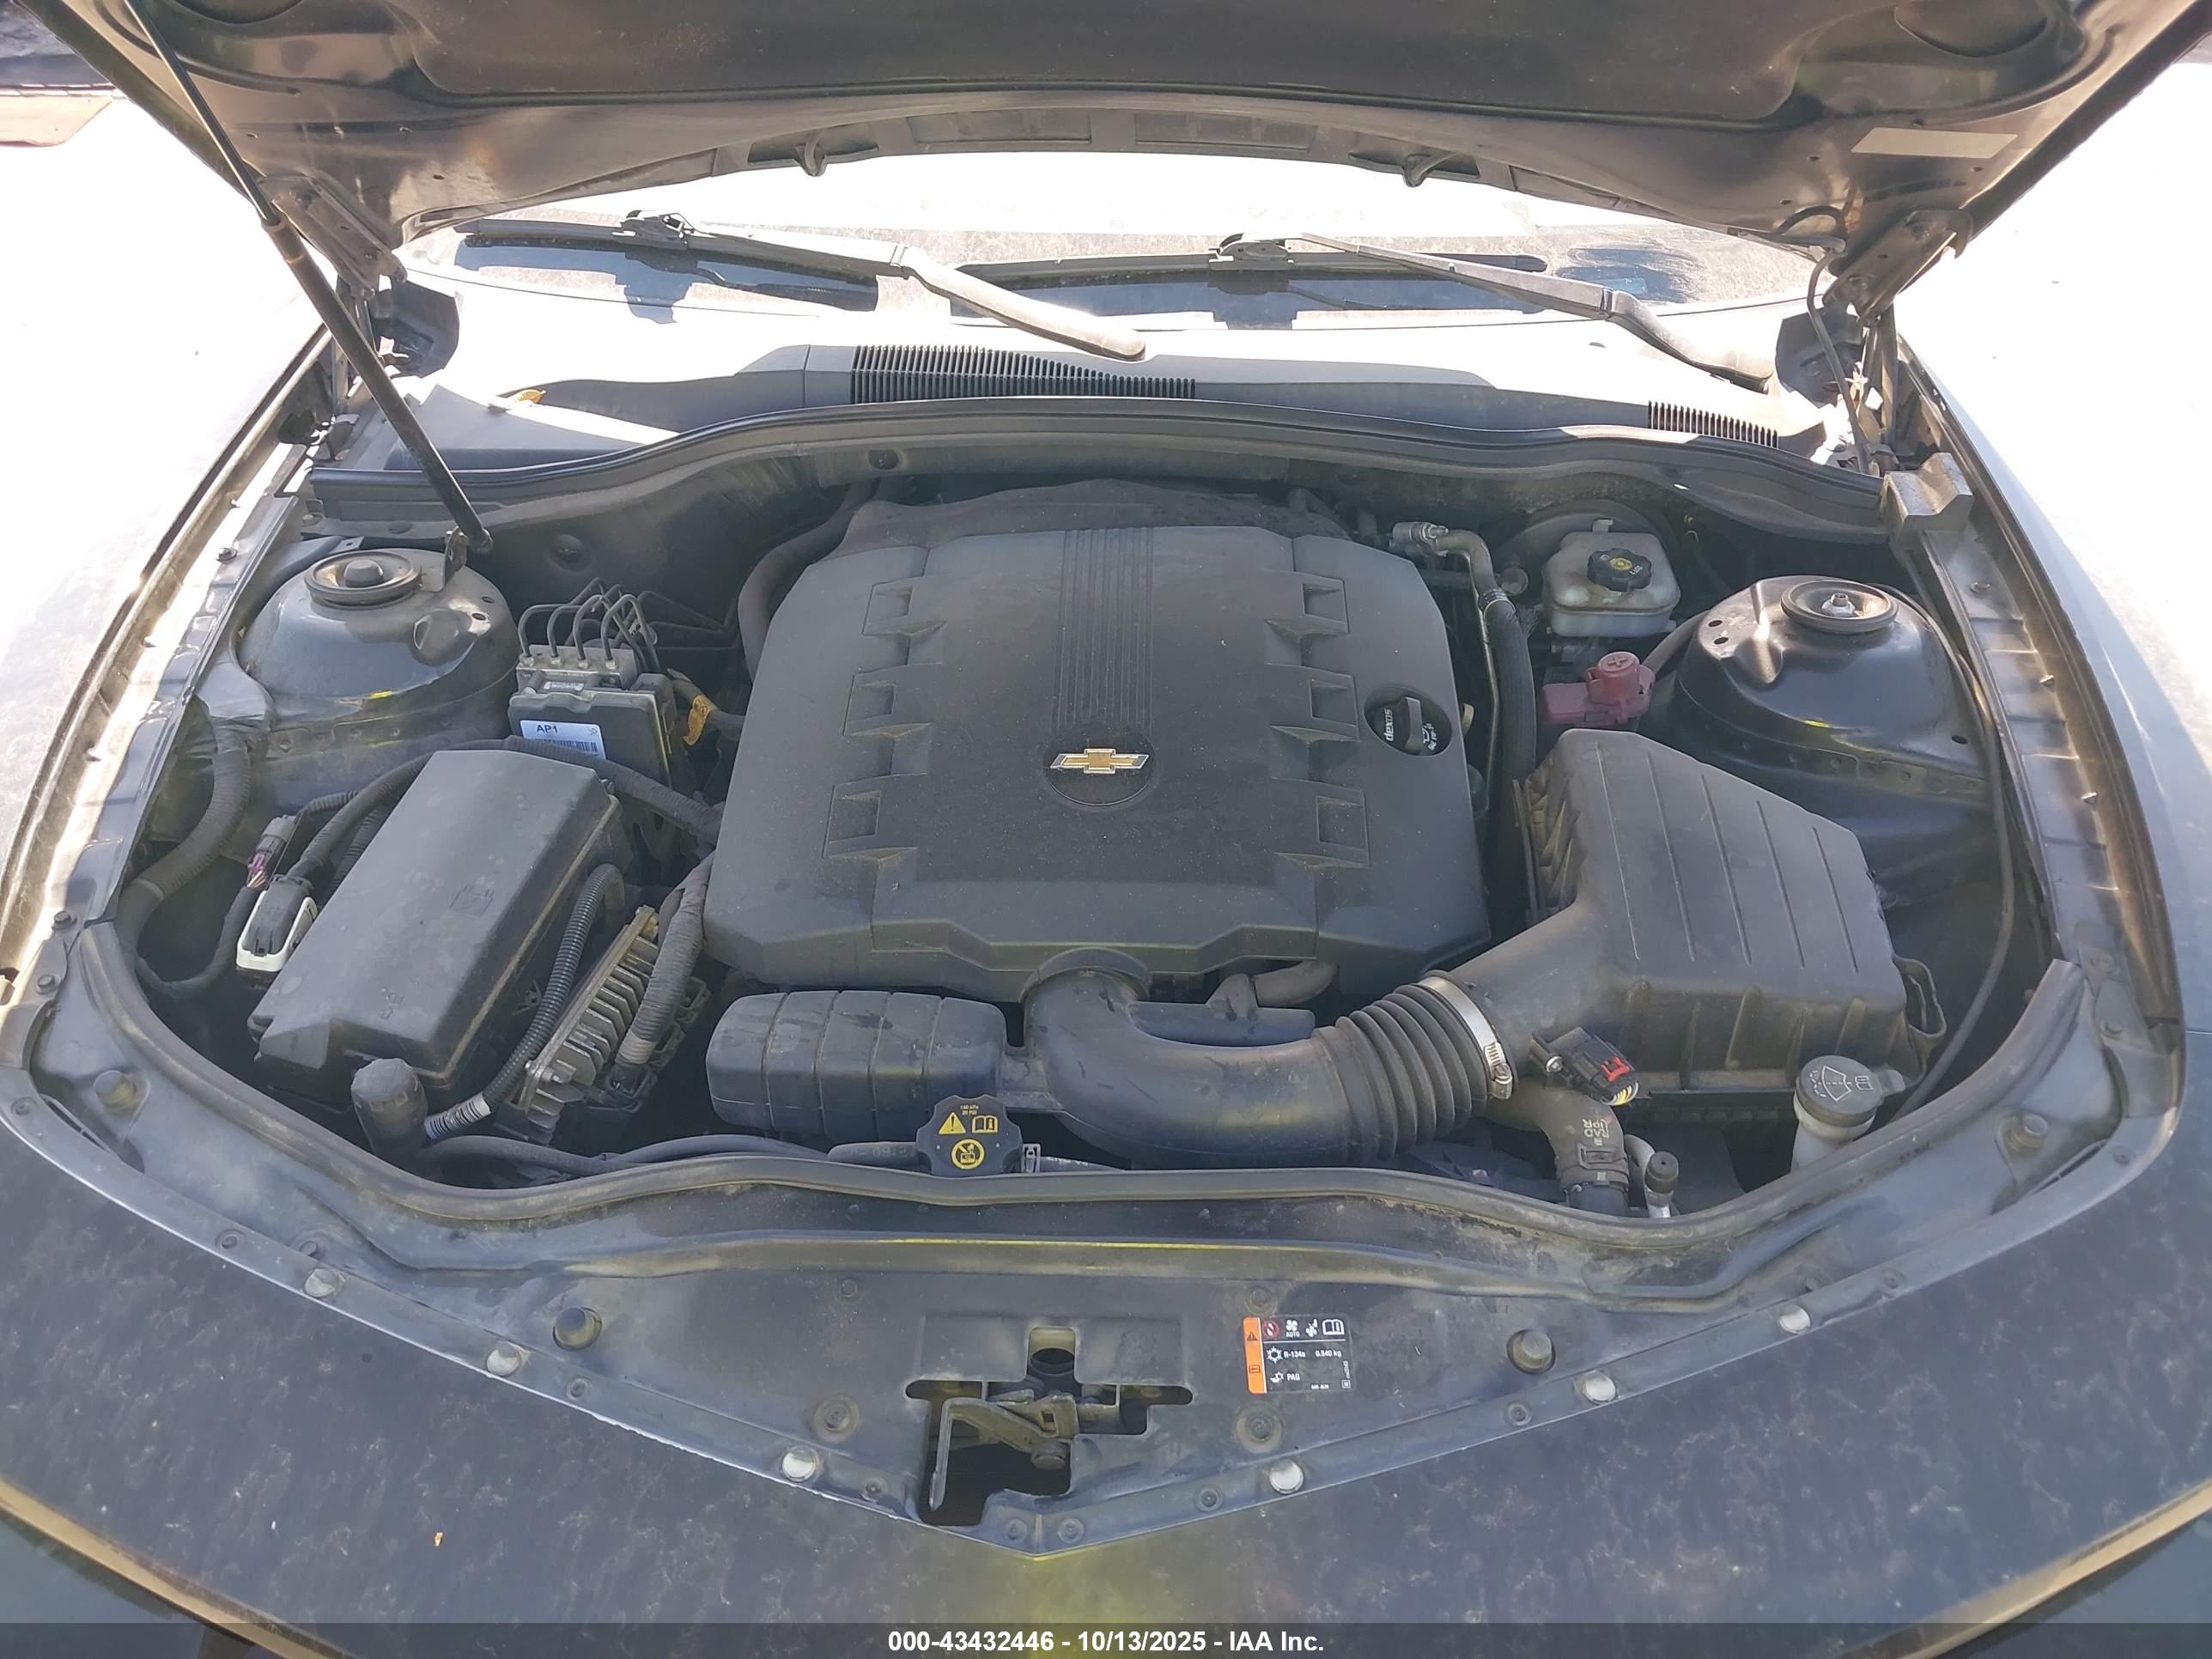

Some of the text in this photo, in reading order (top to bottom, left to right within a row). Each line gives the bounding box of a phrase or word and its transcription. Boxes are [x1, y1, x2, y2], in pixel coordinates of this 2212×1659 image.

[536, 724, 558, 734] AP1
[1383, 708, 1395, 742] dexos
[1283, 1350, 1306, 1358] R-134a
[1333, 1349, 1342, 1358] kg
[1286, 1373, 1301, 1382] PAG
